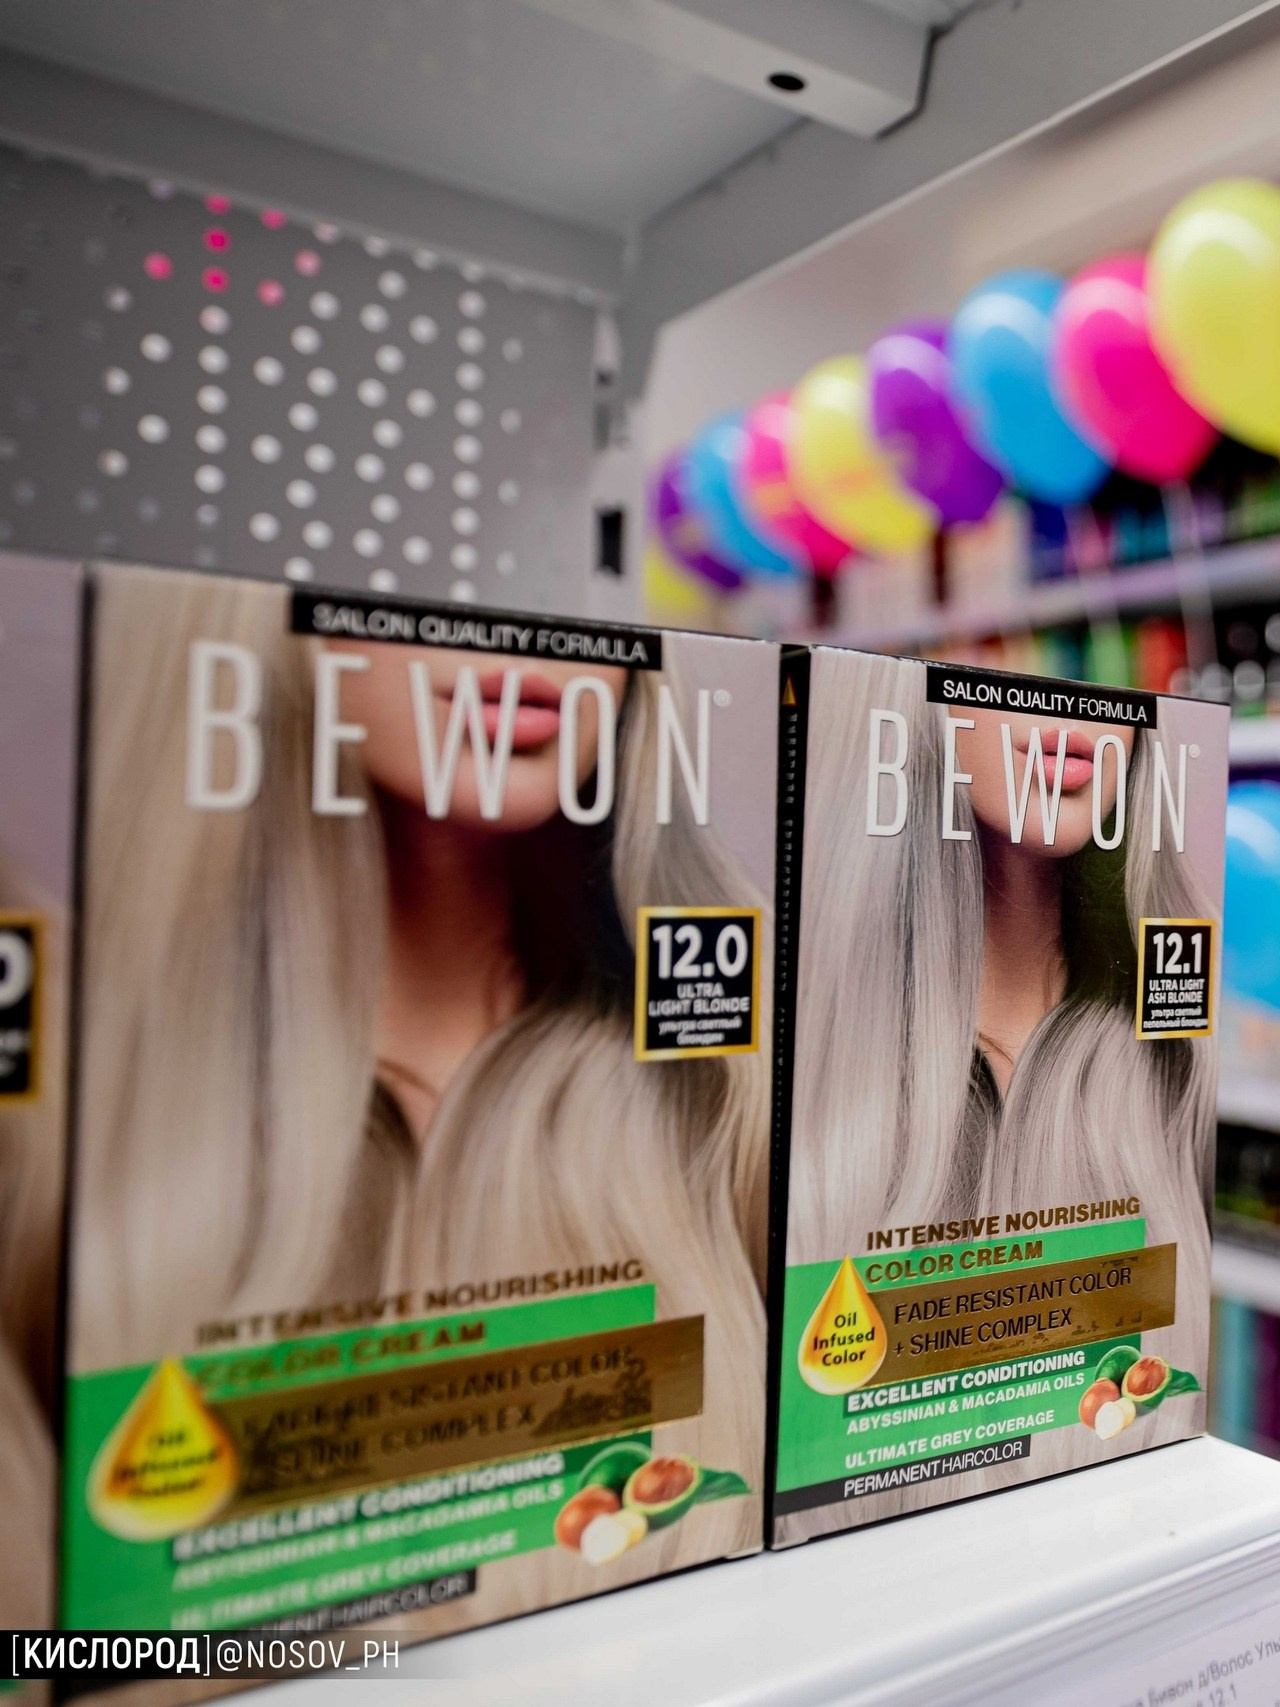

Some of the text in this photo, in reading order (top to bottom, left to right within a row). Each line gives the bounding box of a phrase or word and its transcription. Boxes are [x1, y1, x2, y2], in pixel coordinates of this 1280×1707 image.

[312, 602, 650, 664] SALON QUALITY FORMULA
[942, 679, 1148, 723] SALON QUALITY FORMULA
[184, 639, 712, 827] BEWON
[865, 708, 1188, 854] BEWON
[651, 923, 749, 979] 12.0
[1152, 932, 1203, 974] 12.1
[648, 996, 751, 1017] LIGHT BLONDE
[676, 981, 725, 999] ULTRA
[1147, 990, 1203, 1004] ASH BLONDE
[1148, 978, 1206, 992] ULTRA LIGHT
[866, 1196, 1141, 1251] INTENSIVE NOURISHING
[425, 1258, 645, 1311] NOURISHING
[865, 1240, 1044, 1284] COLOR CREAM
[834, 1311, 858, 1330] Oil
[894, 1266, 1132, 1325] FADE RESISTANT COLOR
[813, 1327, 876, 1351] Infused
[821, 1348, 867, 1367] Color
[893, 1307, 1073, 1357] + SHINE COMPLEX
[846, 1372, 1085, 1435] ABYSSINIAN & MACADAMIA OILS
[847, 1350, 1086, 1412] EXCELLENT CONDITIONING
[845, 1409, 1055, 1470] ULTIMATE GREY COVERAGE
[359, 1452, 565, 1518] CONDITIONING
[511, 1479, 565, 1509] OILS
[843, 1440, 1023, 1498] PERMANENT HAIRCOLOR
[384, 1527, 518, 1582] COVERAGE
[1197, 1650, 1254, 1692] д/Волос
